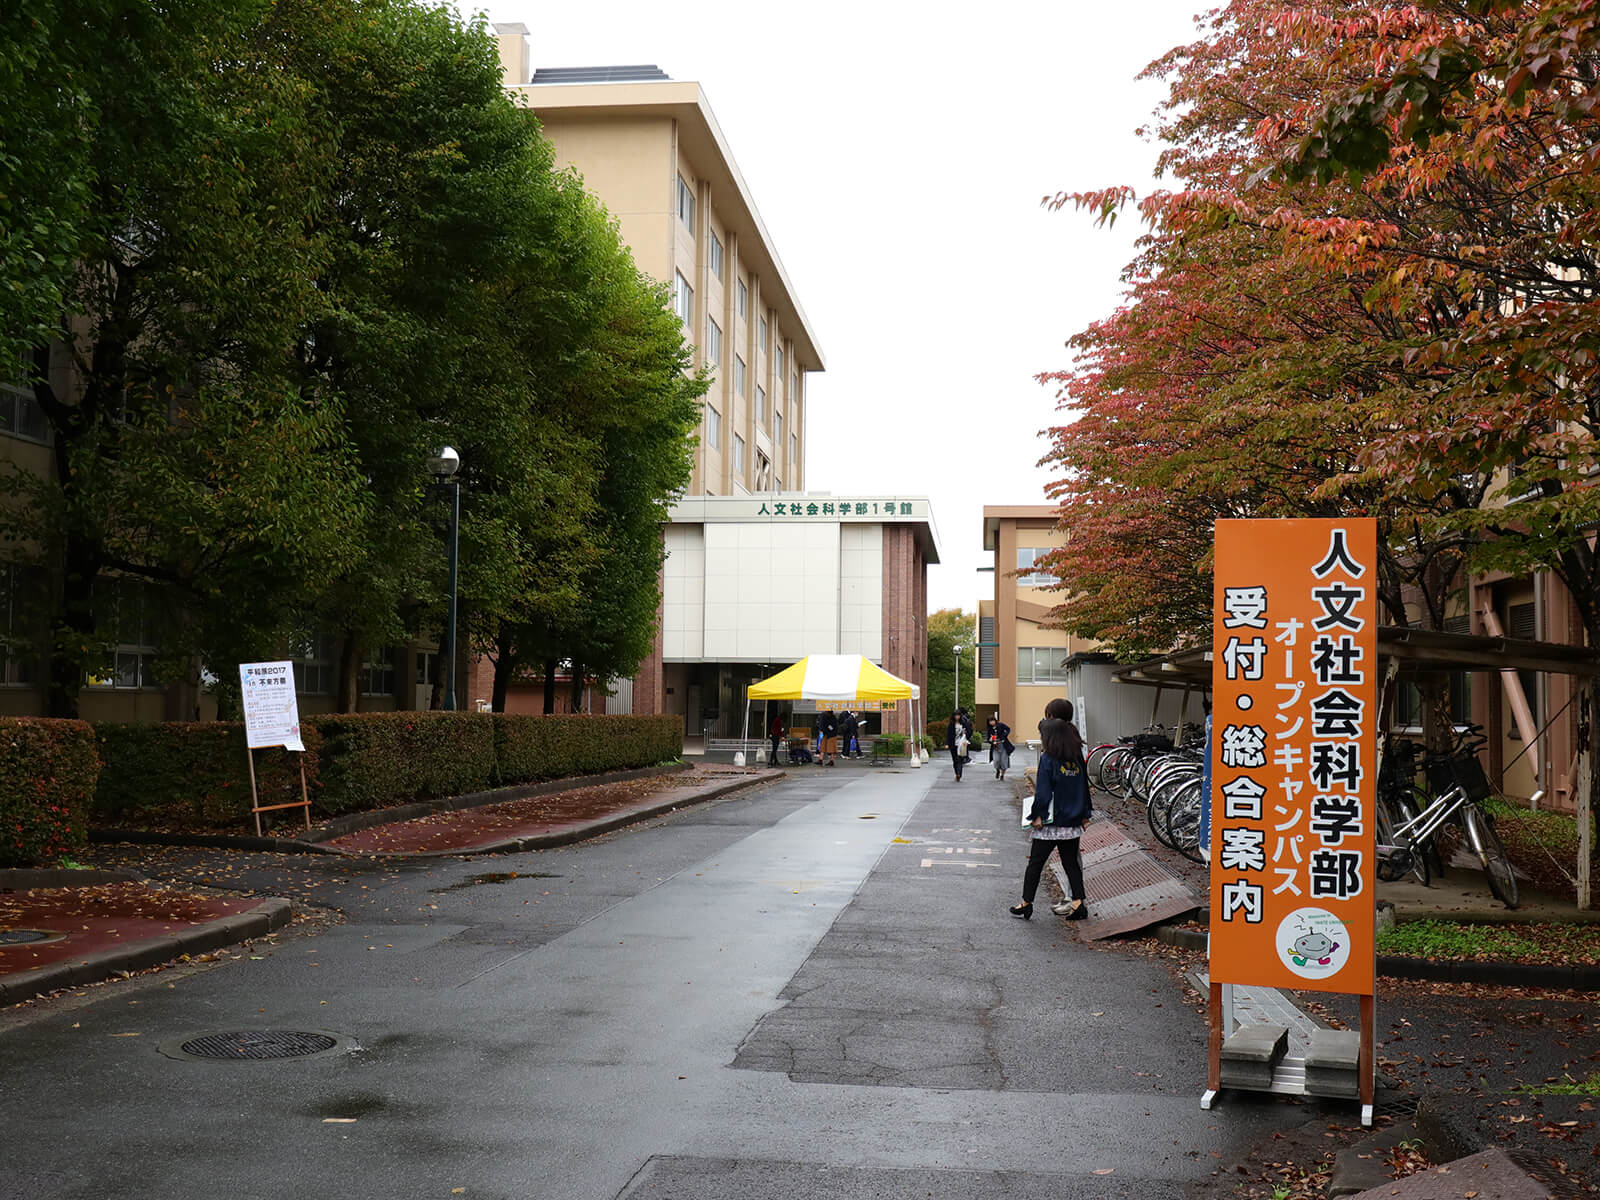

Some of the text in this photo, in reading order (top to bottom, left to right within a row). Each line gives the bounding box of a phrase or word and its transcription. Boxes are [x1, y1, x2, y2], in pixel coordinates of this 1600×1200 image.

[757, 502, 913, 515] 人文社会科学部1号館
[1221, 585, 1268, 923] 受付・総合案内
[1272, 617, 1305, 897] オープンキャンパス
[1309, 528, 1366, 900] 人文社会科学部
